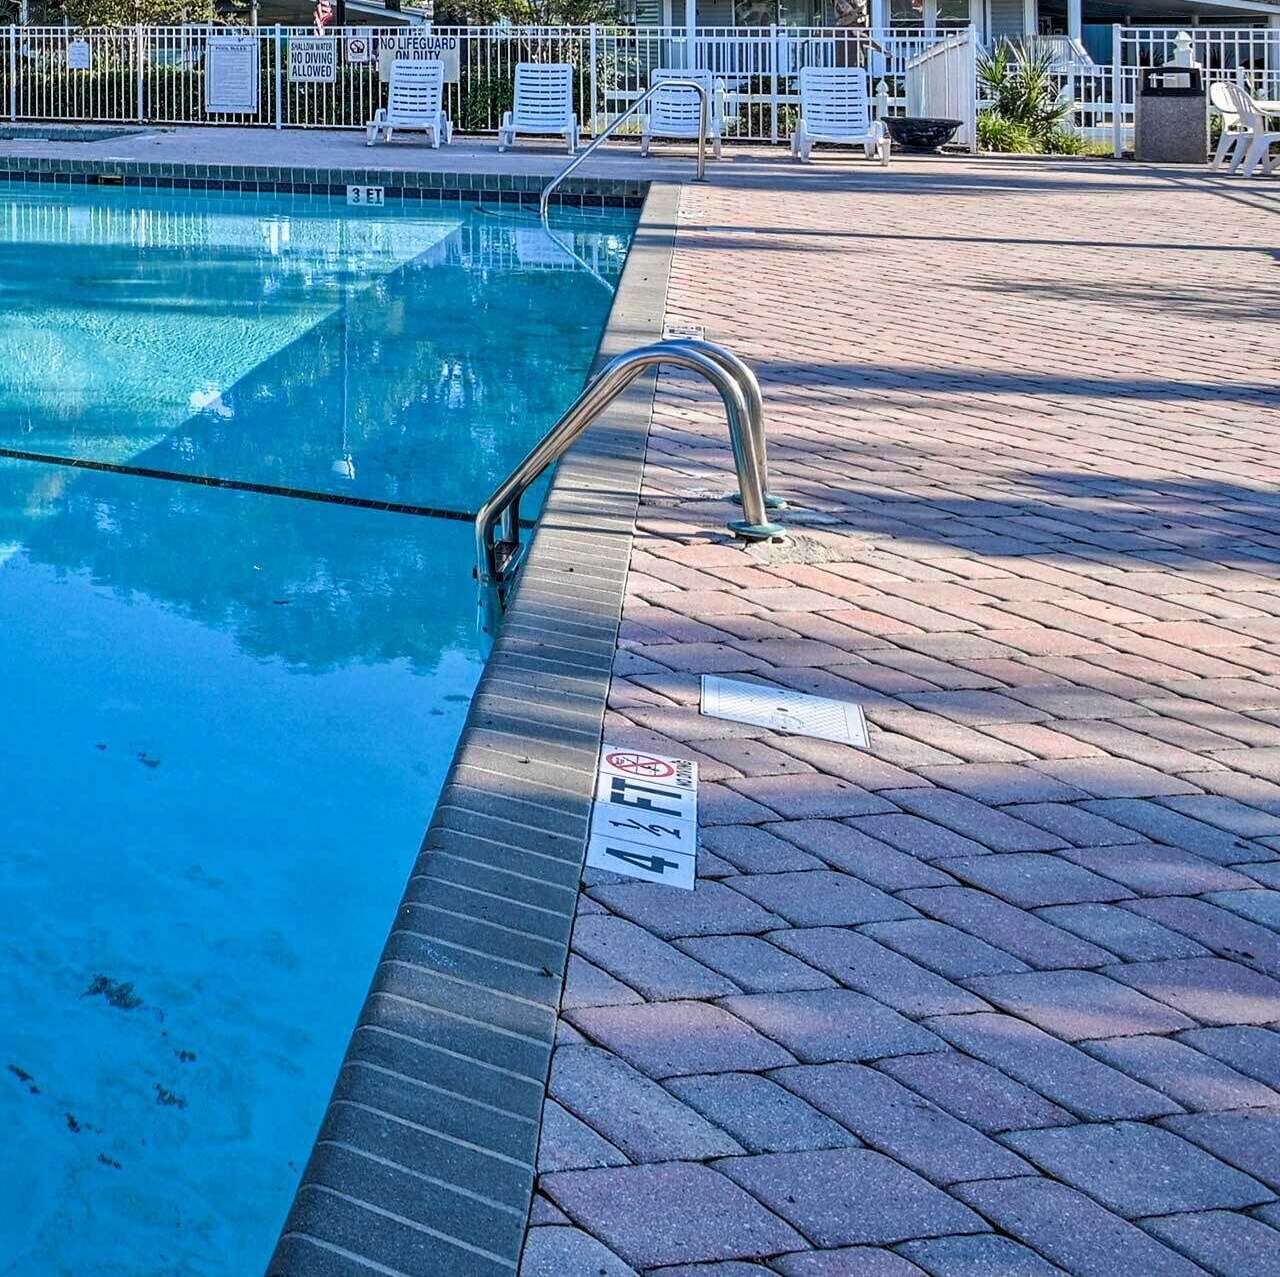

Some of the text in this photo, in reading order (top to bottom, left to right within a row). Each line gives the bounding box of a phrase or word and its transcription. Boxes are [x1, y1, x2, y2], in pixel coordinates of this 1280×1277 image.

[290, 42, 333, 51] SHALLOW WATER
[380, 37, 456, 50] NO LIFEGUARD
[291, 52, 333, 64] NO DIVING
[395, 50, 441, 60] ON DUTY
[292, 65, 332, 77] ALLOWED
[610, 777, 682, 817] FT
[605, 847, 679, 875] 4
